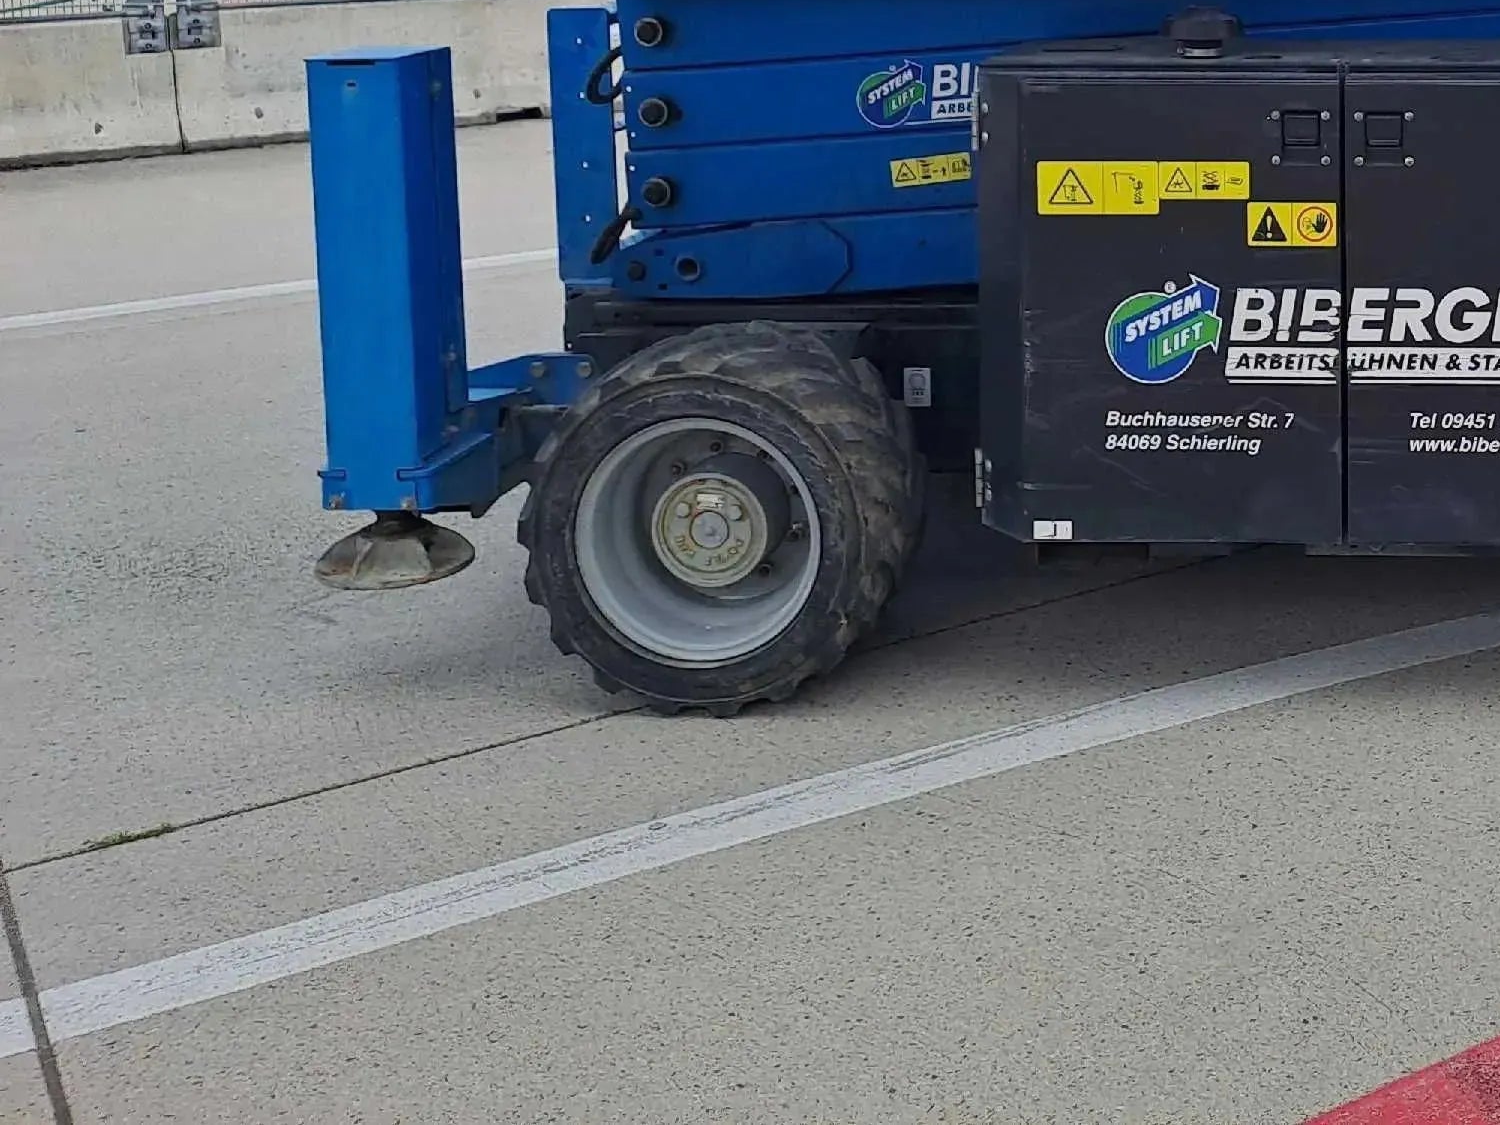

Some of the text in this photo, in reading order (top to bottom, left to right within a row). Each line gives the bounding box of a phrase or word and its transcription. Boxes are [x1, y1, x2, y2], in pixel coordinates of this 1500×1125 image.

[867, 68, 914, 104] SYSTEM
[891, 87, 916, 111] LIFT
[1124, 290, 1202, 343] SYSTEM
[1161, 321, 1204, 356] LIFT
[1235, 352, 1438, 372] ARBEITSÜHNEN
[1445, 353, 1461, 371] &
[1105, 411, 1295, 429] Buchhausener Str. 7
[1410, 412, 1437, 429] Tel
[1441, 413, 1496, 429] 09451
[1105, 434, 1262, 455] 84069 Schierling
